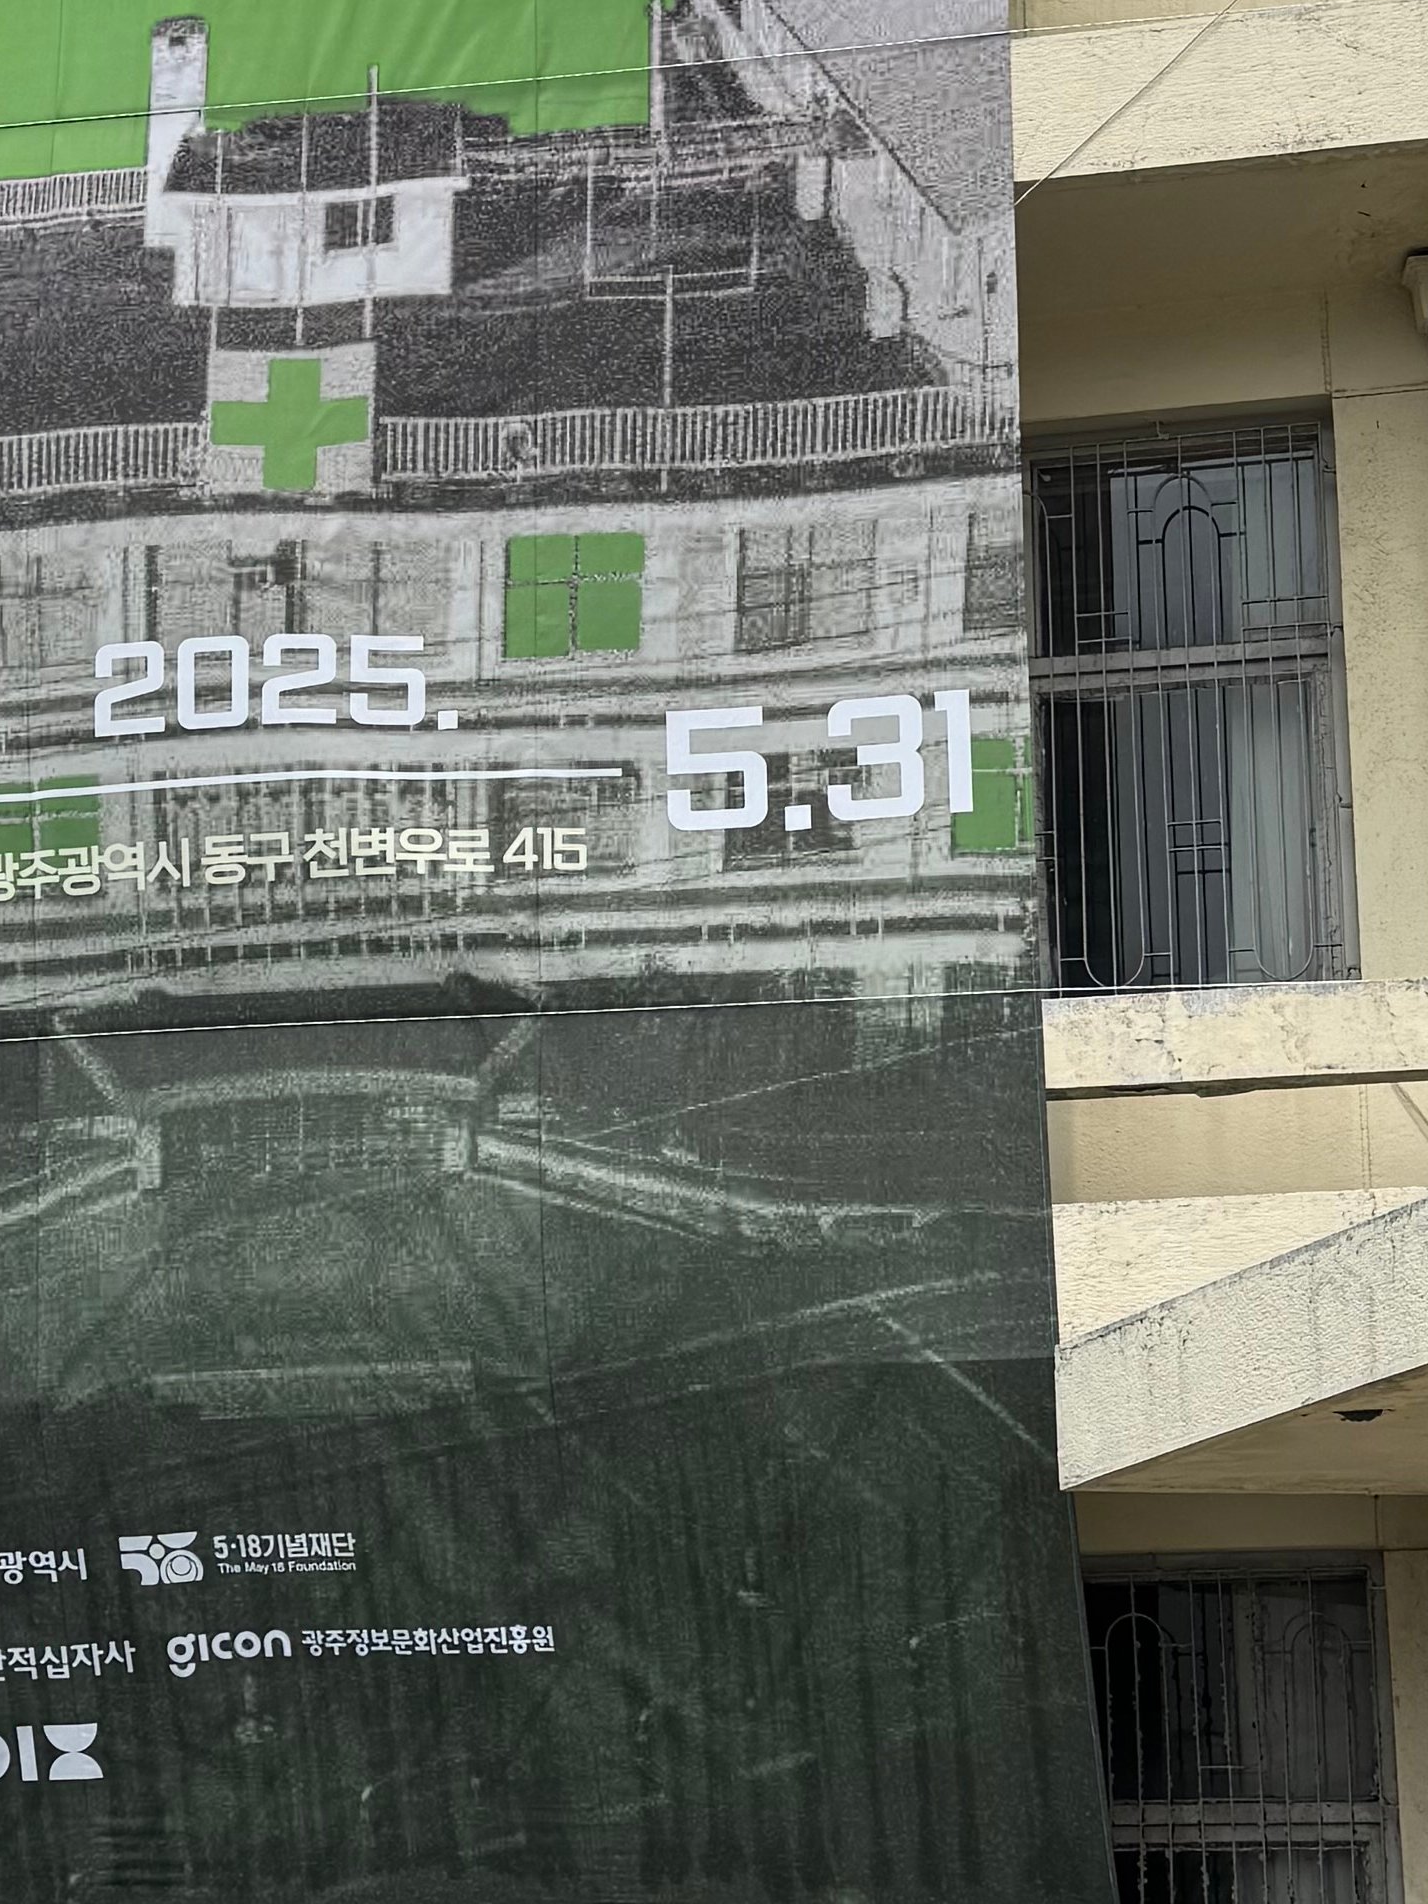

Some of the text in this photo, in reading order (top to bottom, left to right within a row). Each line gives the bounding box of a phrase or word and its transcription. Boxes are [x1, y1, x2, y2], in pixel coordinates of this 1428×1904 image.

[92, 633, 459, 737] 2025.
[664, 688, 972, 832] 5.31
[200, 830, 293, 885] 동구
[301, 827, 495, 879] 천변우로
[502, 826, 587, 872] 415
[212, 1532, 356, 1559] 5·18기념재단
[217, 1562, 241, 1574] The
[244, 1561, 270, 1575] May
[287, 1560, 357, 1573] Foundation
[166, 1629, 292, 1678] gicon
[301, 1624, 556, 1657] 광주정보문화산업진흥원
